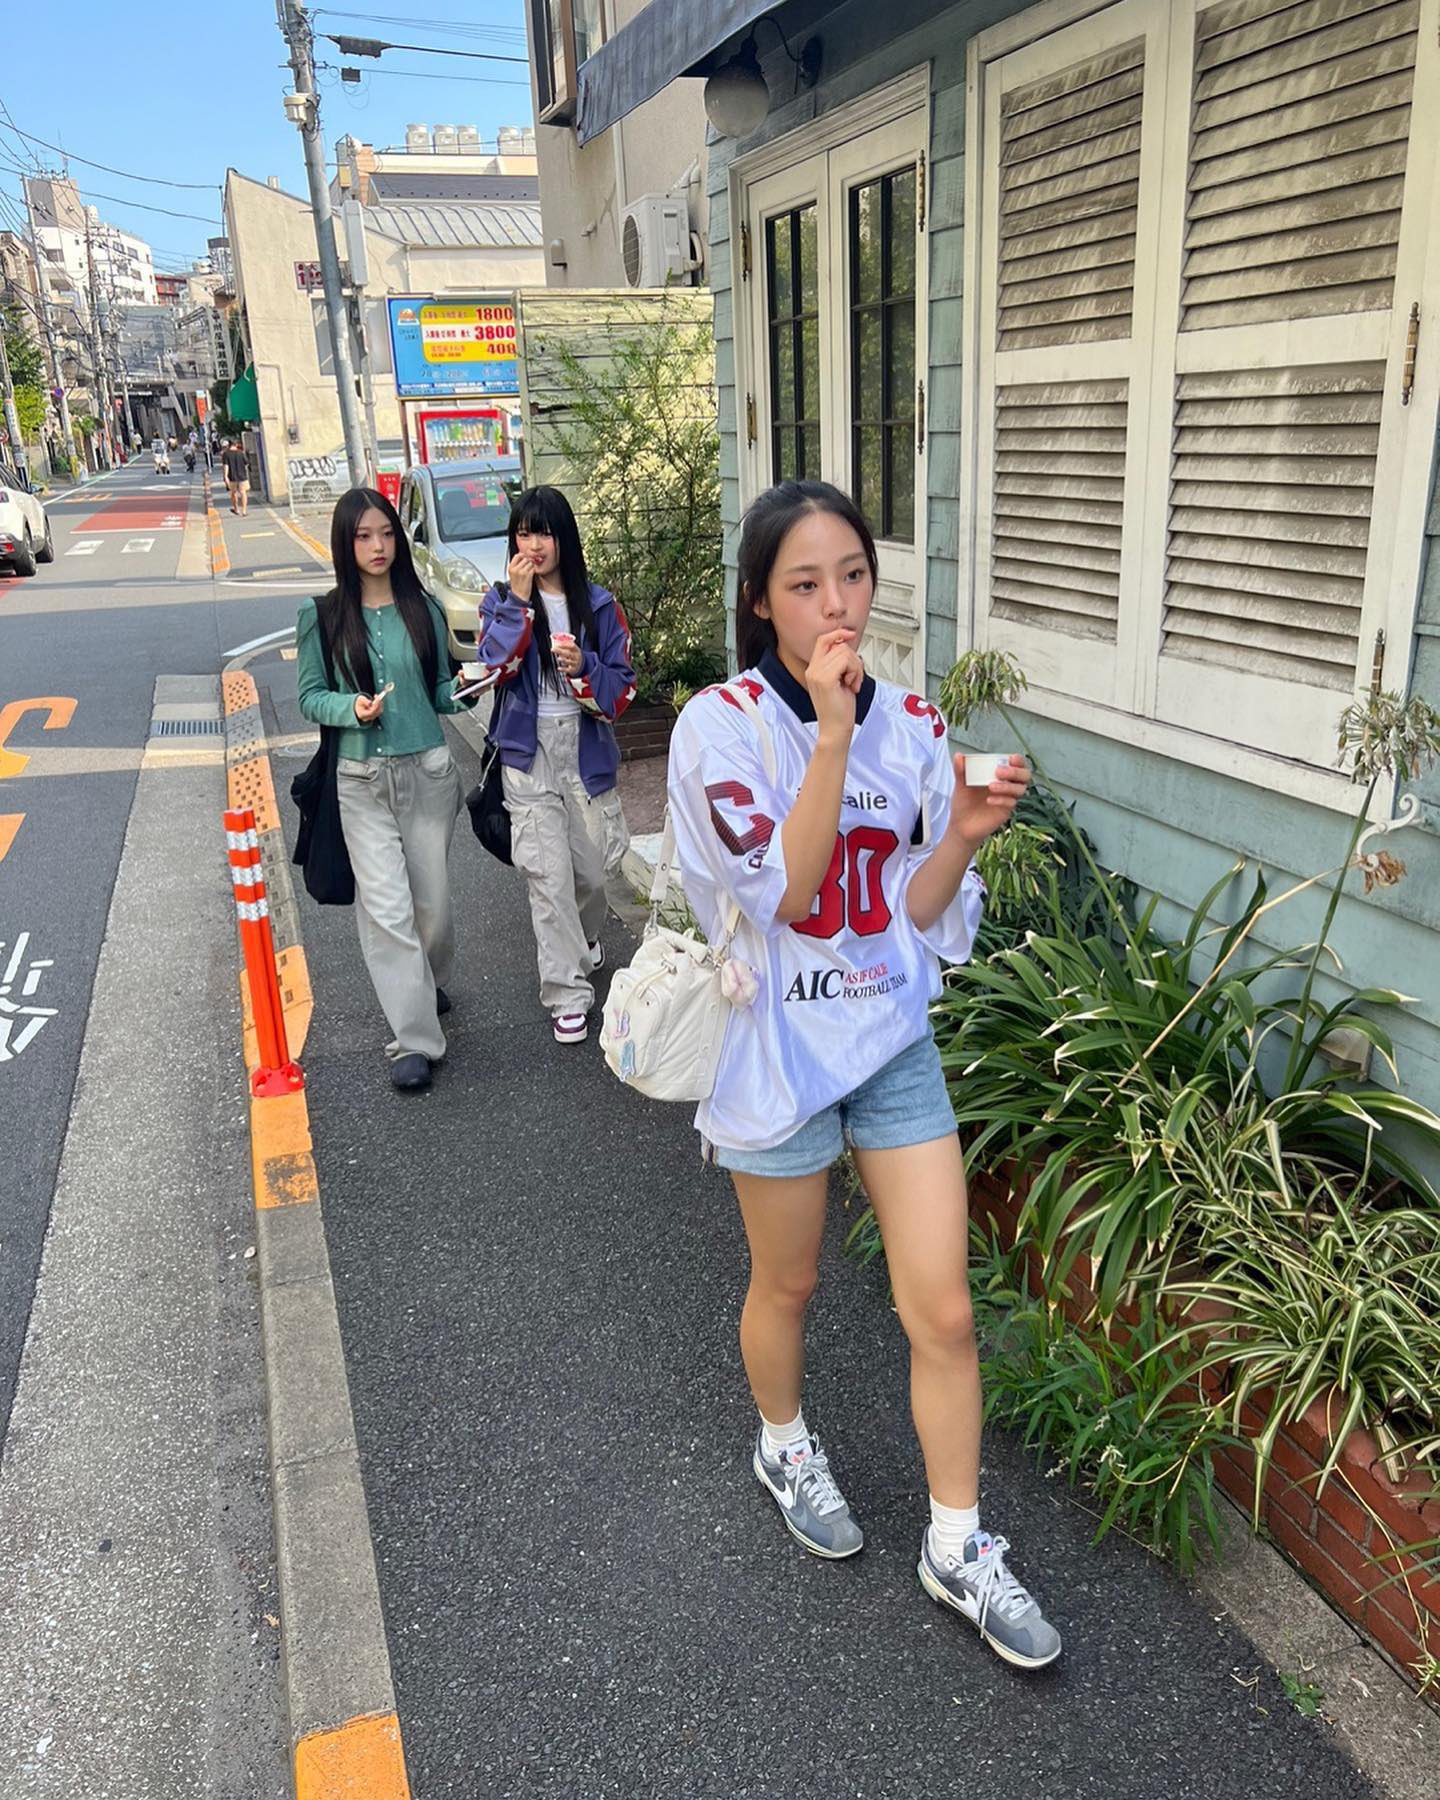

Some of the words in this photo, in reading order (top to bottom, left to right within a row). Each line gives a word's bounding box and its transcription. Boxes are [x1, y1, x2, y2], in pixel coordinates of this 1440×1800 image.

[476, 307, 513, 321] 1800
[475, 325, 515, 340] 3800
[841, 791, 888, 811] alie
[784, 968, 845, 1002] AIC
[845, 972, 858, 984] AS
[859, 969, 869, 983] IF
[843, 980, 891, 999] FOOTBALL
[889, 972, 908, 990] TEAM
